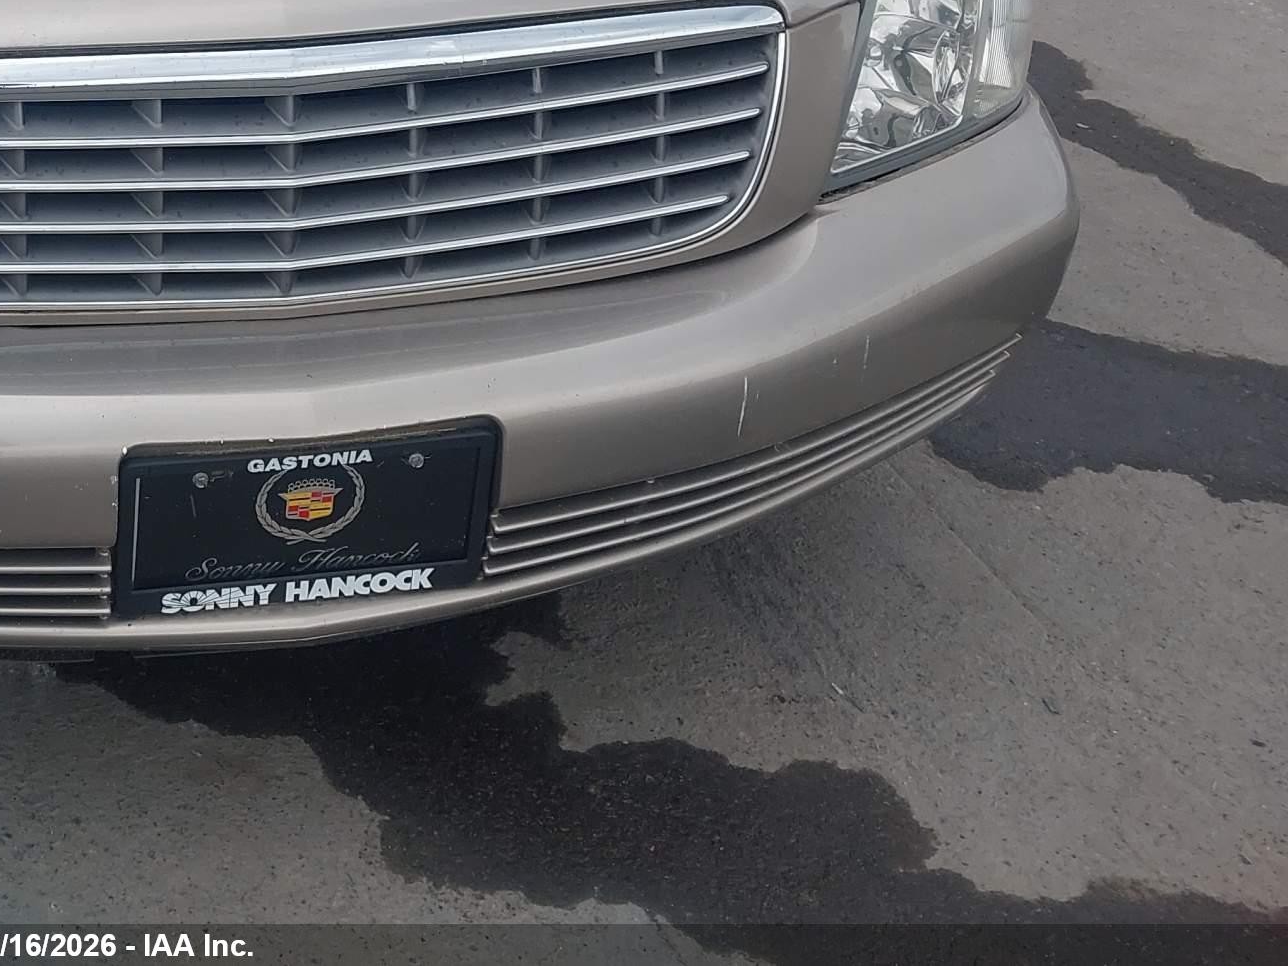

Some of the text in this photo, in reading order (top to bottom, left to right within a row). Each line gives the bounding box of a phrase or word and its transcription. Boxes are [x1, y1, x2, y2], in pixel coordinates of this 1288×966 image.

[247, 449, 373, 473] GASTONIA
[161, 568, 435, 614] SONNY HANCOCK
